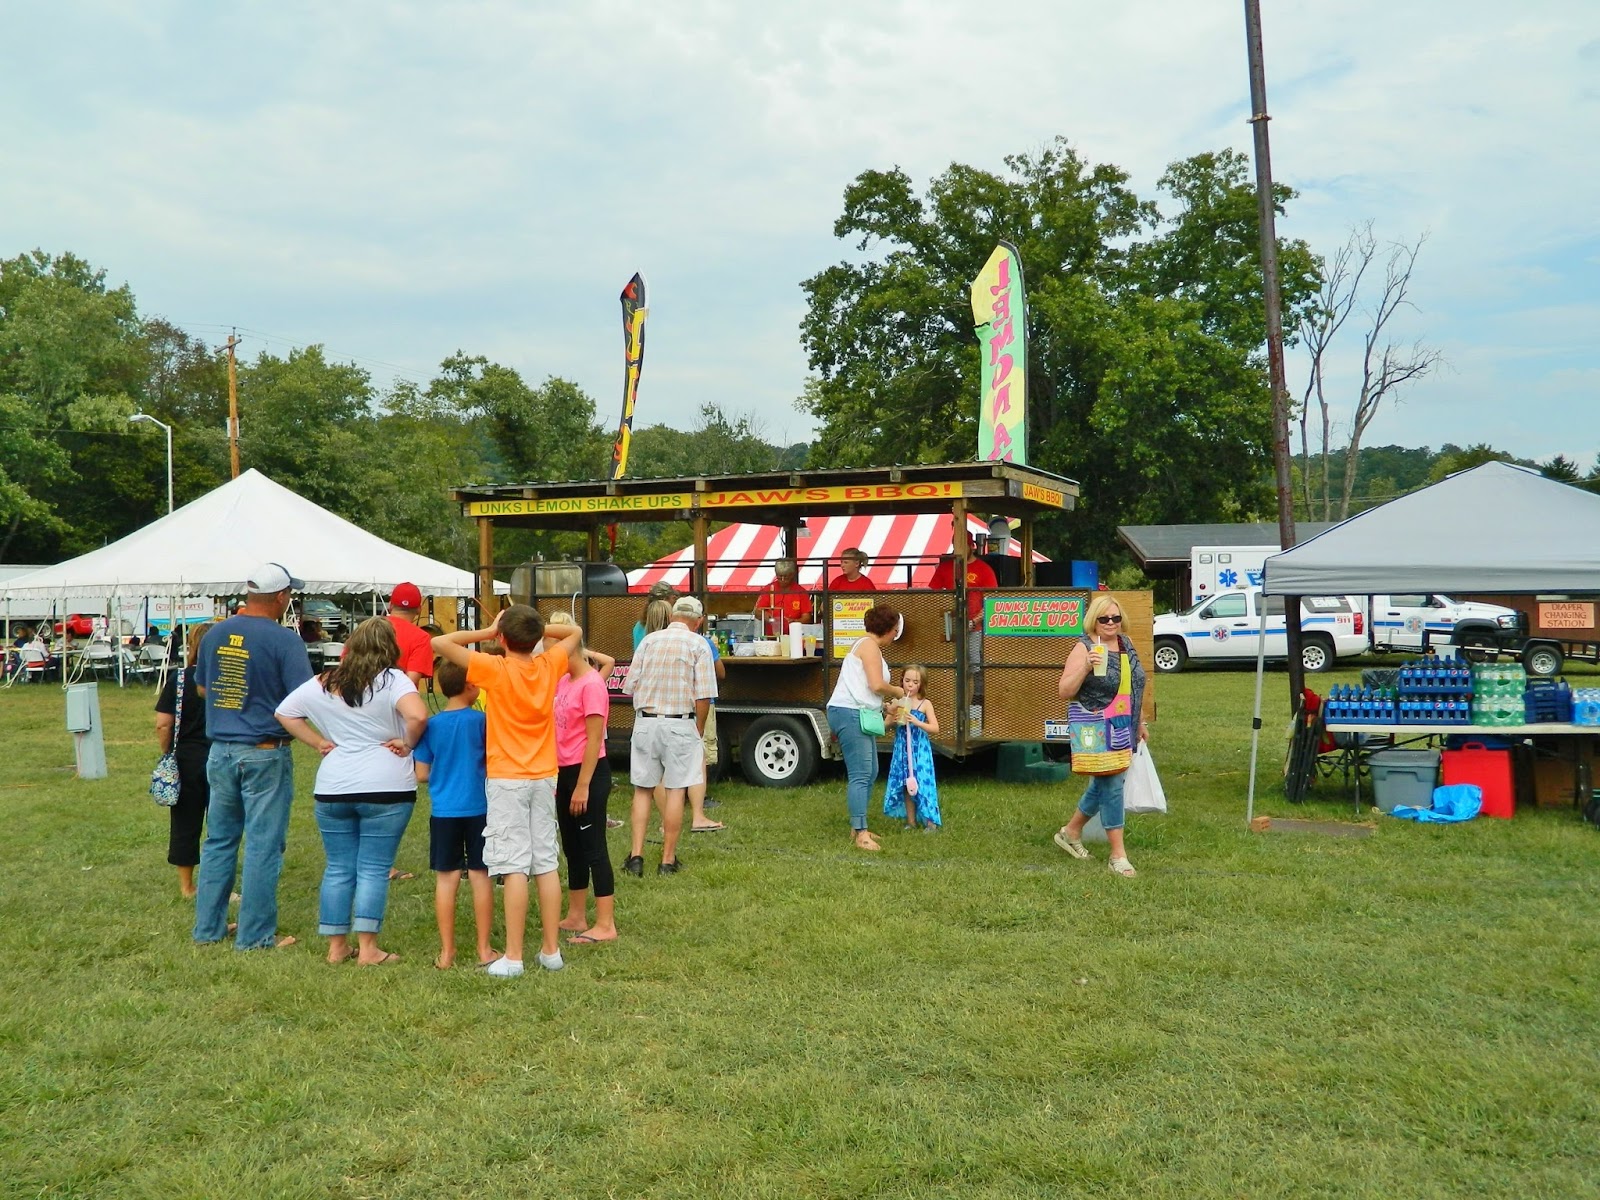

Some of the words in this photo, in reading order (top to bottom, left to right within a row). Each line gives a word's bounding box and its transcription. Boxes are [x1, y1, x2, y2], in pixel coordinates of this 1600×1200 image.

[706, 488, 831, 505] JAW'S
[844, 484, 952, 500] BBQ!
[1046, 491, 1062, 505] BBQ!
[480, 502, 522, 515] UNKS
[526, 499, 584, 513] LEMON
[587, 496, 643, 511] SHAKE
[648, 495, 682, 508] UPS
[994, 601, 1030, 612] UNKS
[1032, 601, 1080, 612] LEMON
[1551, 603, 1584, 611] DIAPER
[989, 613, 1042, 627] SHAKE
[1047, 613, 1080, 627] UPS
[1544, 611, 1587, 619] CHANGING
[1547, 619, 1585, 627] STATION
